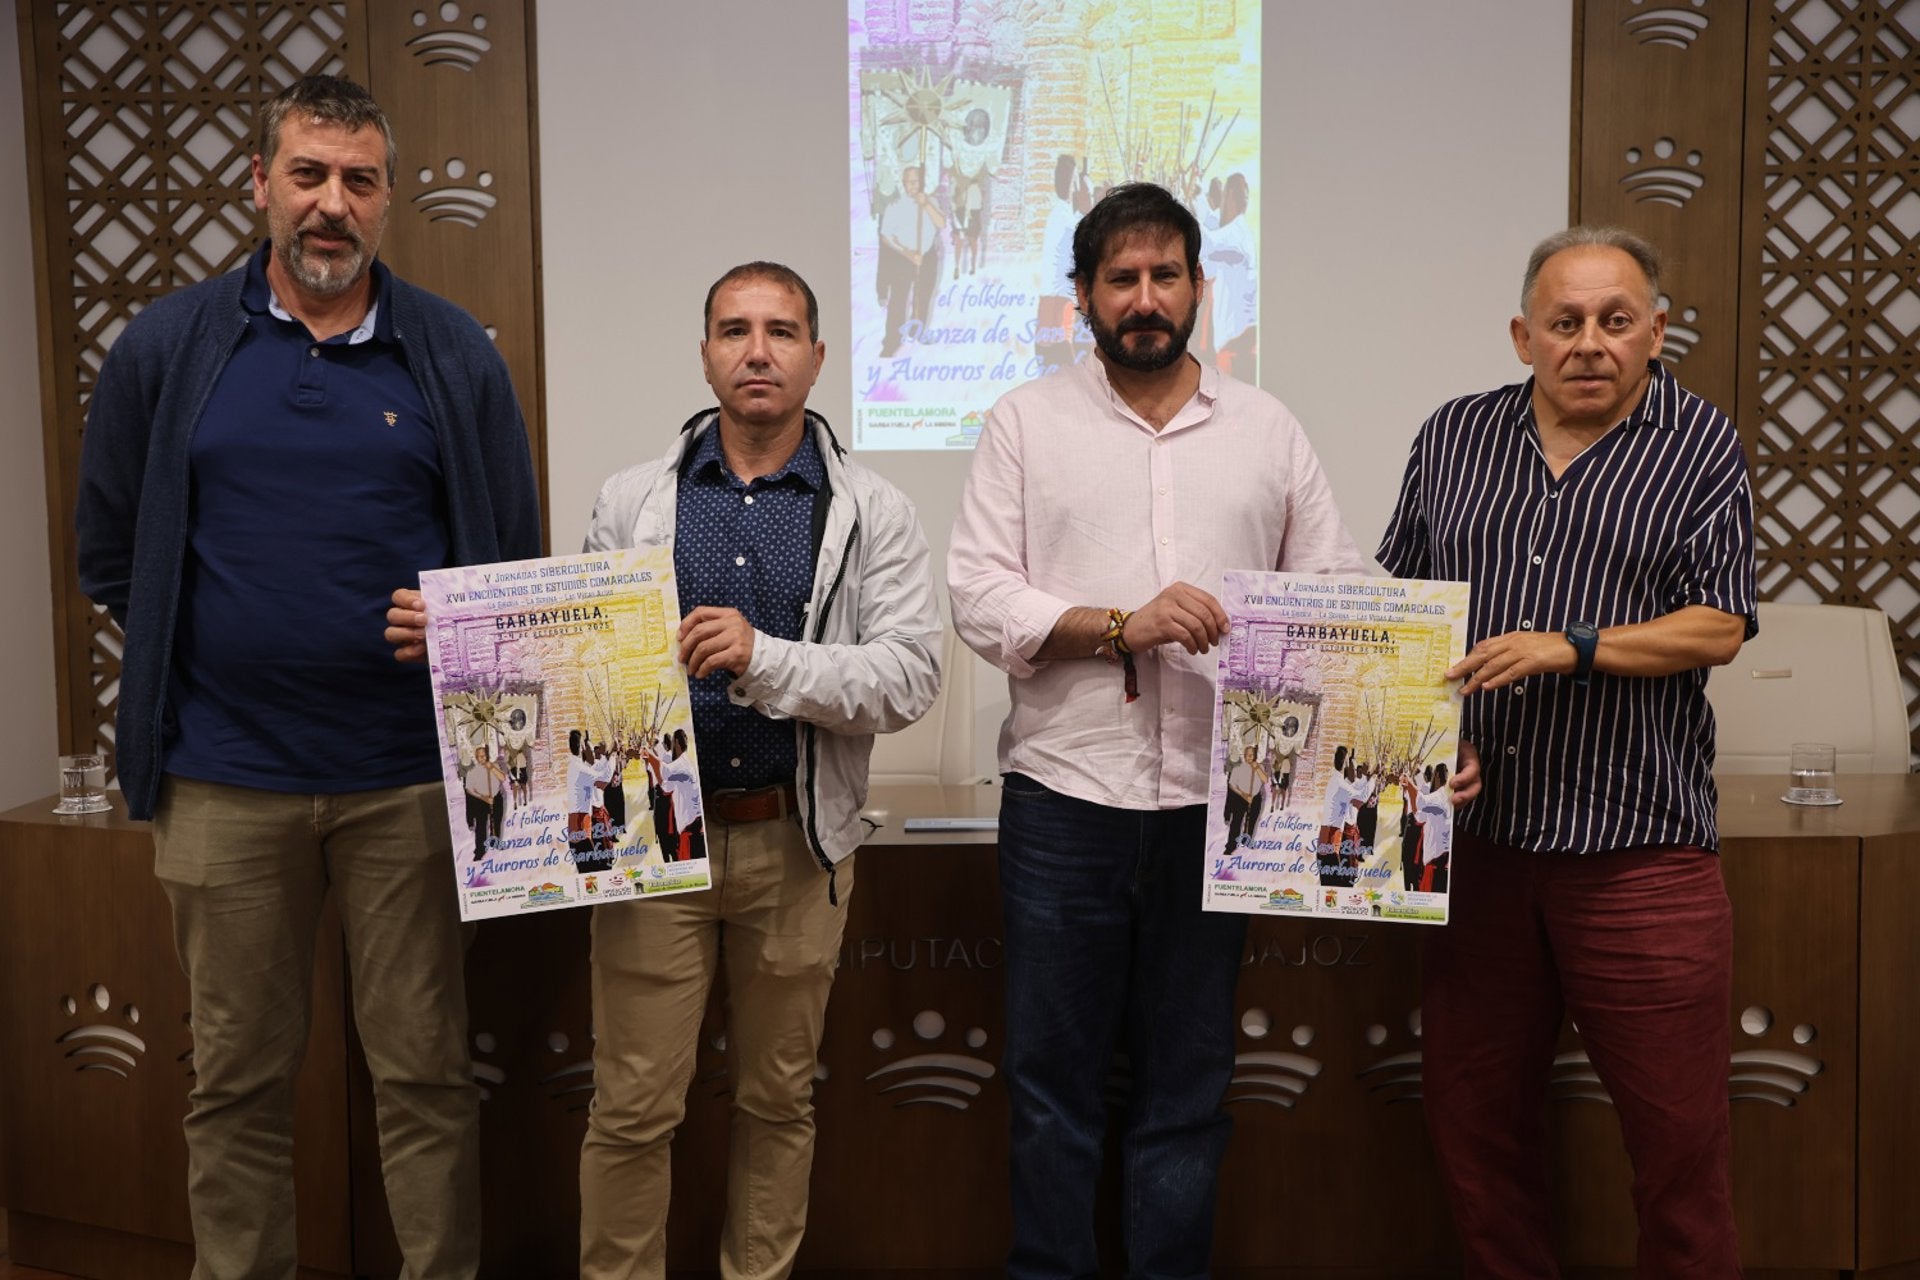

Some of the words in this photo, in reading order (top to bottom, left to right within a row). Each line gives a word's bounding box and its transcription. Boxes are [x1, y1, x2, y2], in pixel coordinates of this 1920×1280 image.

[937, 284, 955, 307] el
[898, 320, 975, 344] Danza
[983, 314, 1010, 344] de
[1017, 319, 1064, 344] San
[860, 365, 882, 395] y
[889, 357, 983, 382] Auroros
[990, 352, 1016, 381] de
[868, 408, 957, 417] FUENTELAMORA
[484, 574, 491, 583] V
[540, 561, 610, 578] SIBERCULTURA
[446, 592, 466, 604] XVII
[469, 585, 528, 601] ENCUENTROS
[531, 583, 543, 595] DE
[546, 578, 588, 592] ESTUDIOS
[590, 571, 653, 588] COMARCALES
[1284, 582, 1290, 590] V
[1337, 584, 1406, 597] SIBERCULTURA
[1244, 595, 1263, 604] XVII
[1265, 596, 1324, 608] ENCUENTROS
[1326, 599, 1337, 609] DE
[1340, 600, 1381, 611] ESTUDIOS
[1384, 602, 1446, 615] COMARCALES
[506, 812, 515, 827] el
[1260, 815, 1269, 828] el
[483, 833, 532, 851] Danza
[536, 826, 552, 845] de
[556, 827, 587, 844] San
[1235, 831, 1282, 851] Danza
[1287, 834, 1302, 852] de
[1306, 836, 1338, 855] San
[463, 865, 476, 886] y
[480, 858, 539, 876] Auroros
[543, 851, 559, 867] de
[564, 837, 649, 869] Garbayuela
[1210, 857, 1224, 877] y
[1227, 855, 1285, 874] Auroros
[1289, 856, 1305, 874] de
[1309, 860, 1392, 885] Garbayuela
[470, 886, 526, 897] FUENTELAMORA
[1214, 884, 1267, 893] FUENTELAMORA
